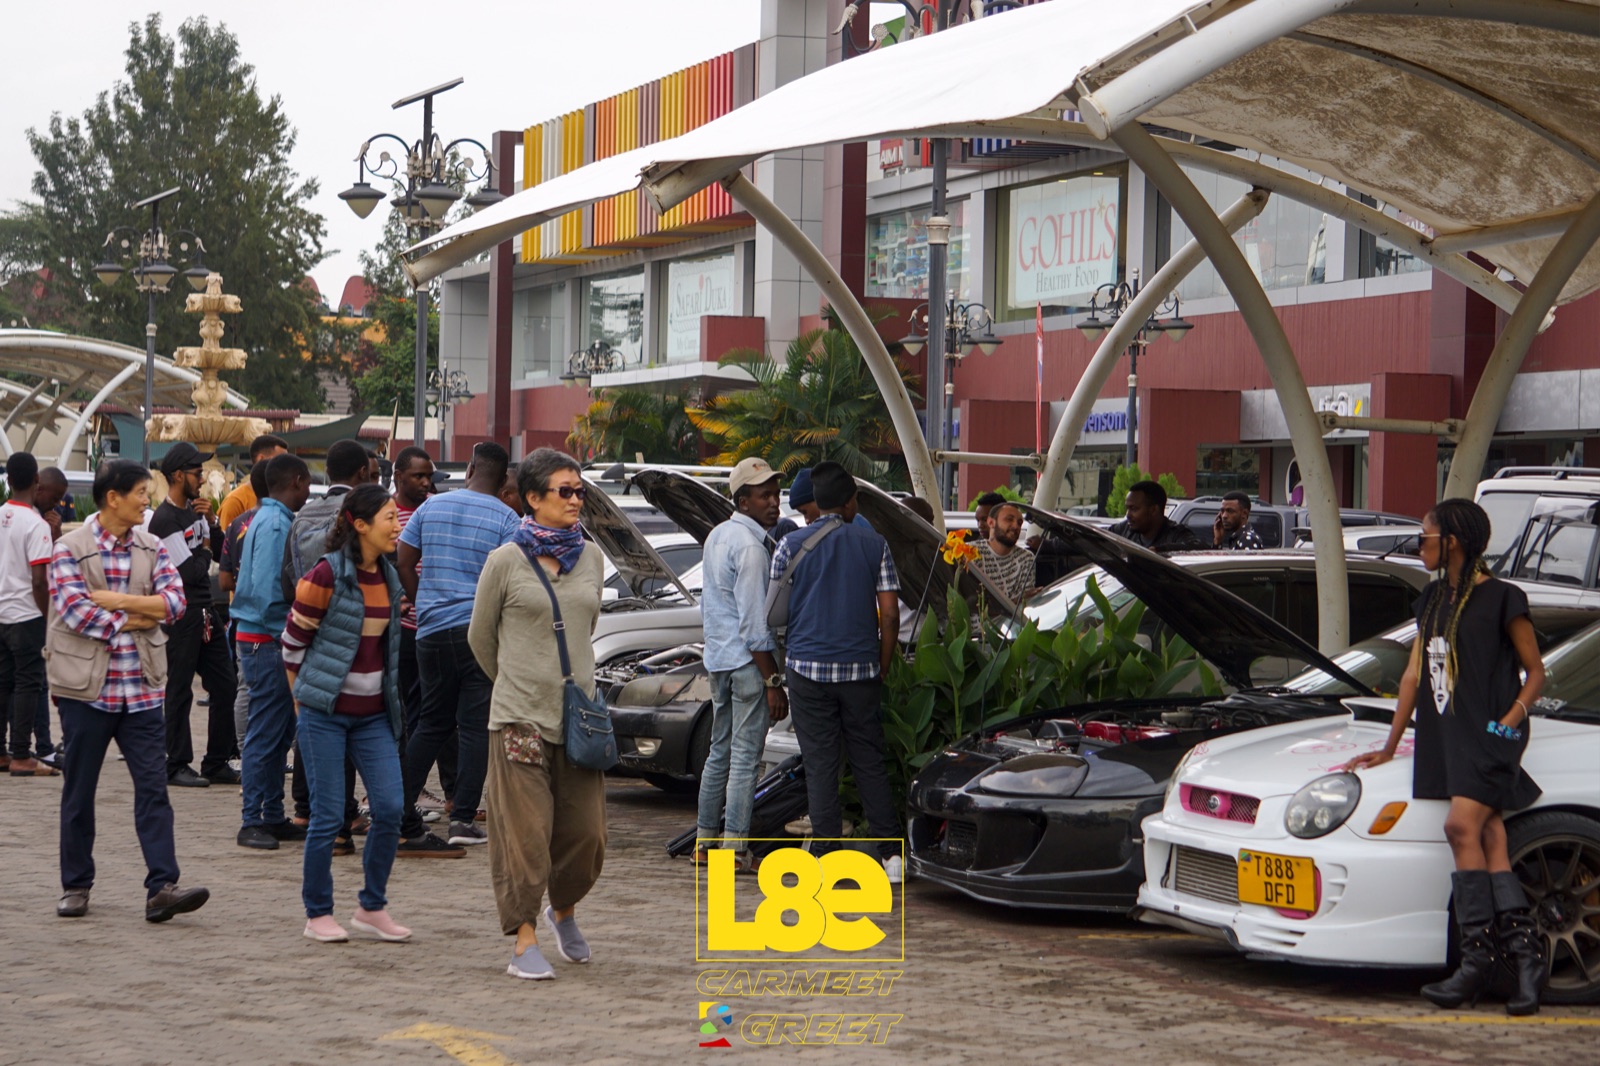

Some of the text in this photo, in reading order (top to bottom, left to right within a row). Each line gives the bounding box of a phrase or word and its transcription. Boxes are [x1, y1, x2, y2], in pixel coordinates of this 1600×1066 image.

[1036, 265, 1099, 293] HEALTHY FOOD
[676, 275, 727, 318] SAFARI DUKA
[1083, 411, 1125, 432] enson
[1254, 854, 1294, 880] T888
[1264, 881, 1295, 905] DFD
